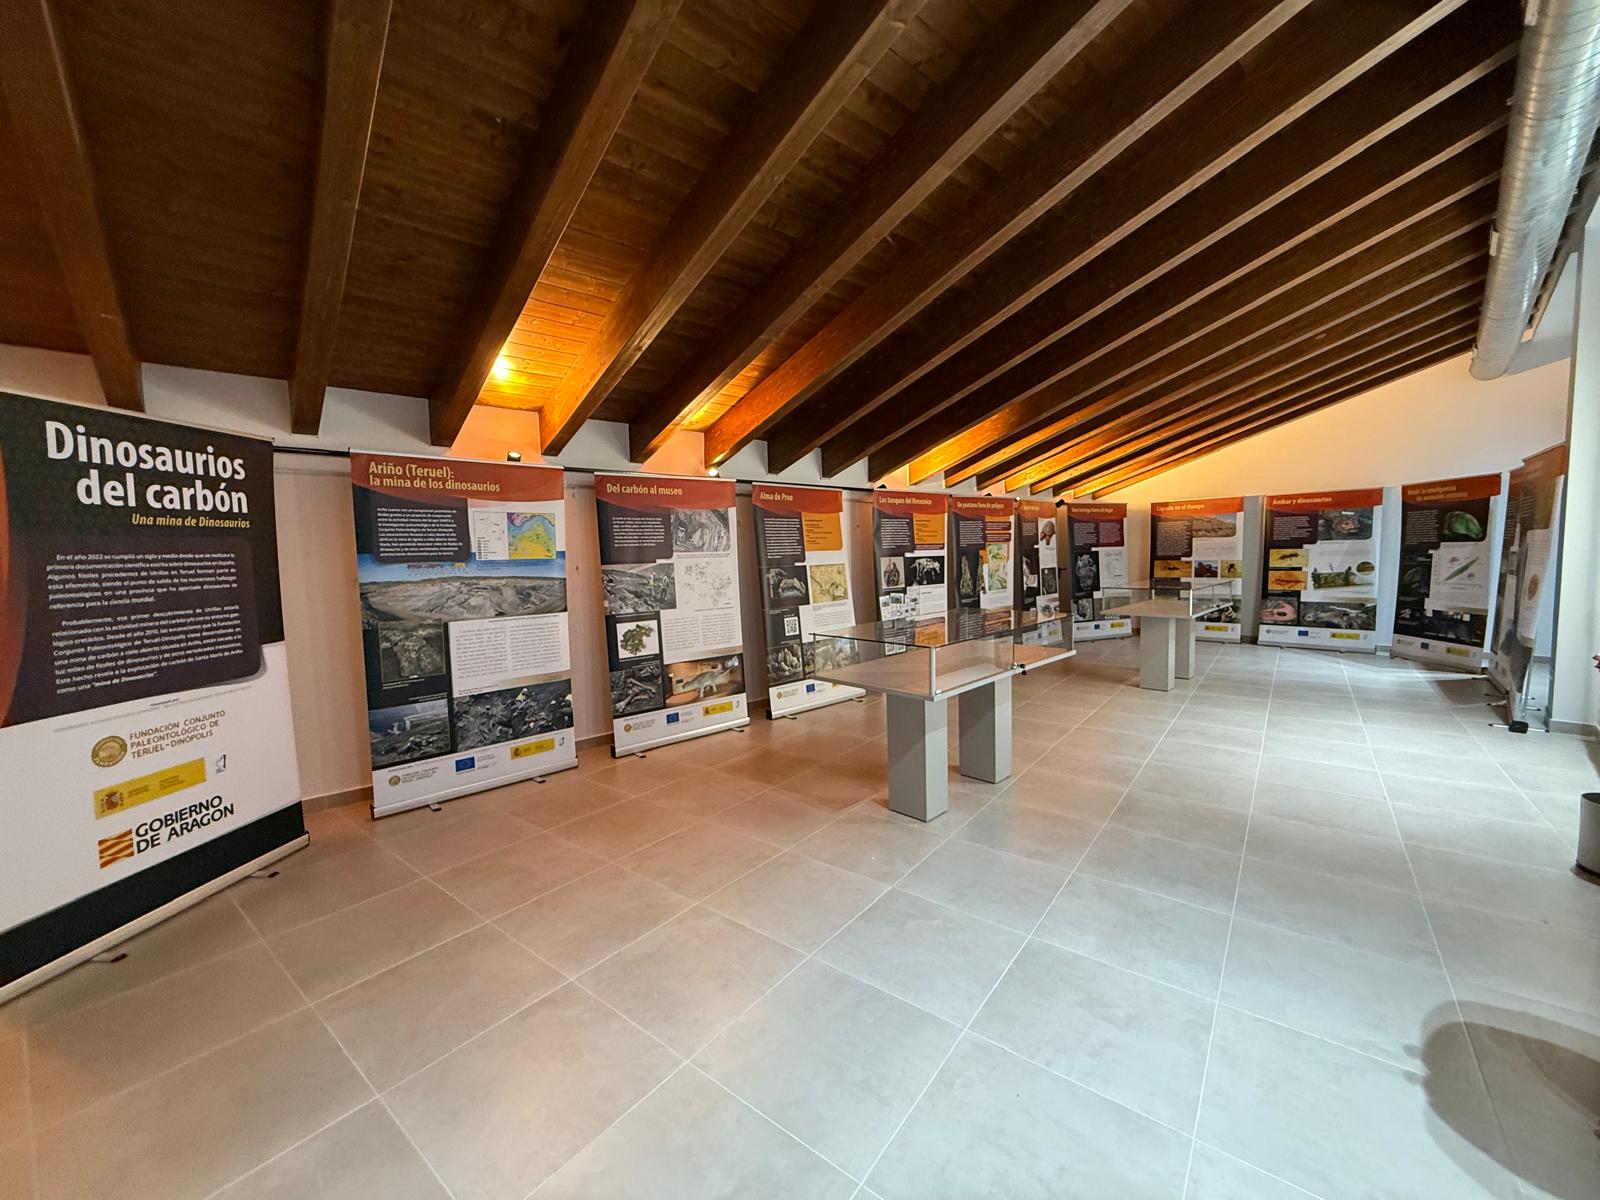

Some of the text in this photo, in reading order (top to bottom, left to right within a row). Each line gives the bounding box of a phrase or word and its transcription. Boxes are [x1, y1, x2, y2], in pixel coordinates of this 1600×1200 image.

[45, 420, 246, 480] Dinosaurios
[368, 461, 454, 478] Ariño (Teruel):
[77, 469, 248, 514] del carbón
[370, 476, 500, 492] la mina de los dinosaurios
[606, 483, 682, 496] Del carbón al museo
[760, 491, 773, 500] Alma
[774, 492, 781, 500] de
[132, 514, 250, 528] Una mina de Dinosaurios
[184, 710, 225, 726] CONJUNTO
[135, 795, 222, 838] GOBIERNO
[136, 803, 234, 854] DE ARAGON
